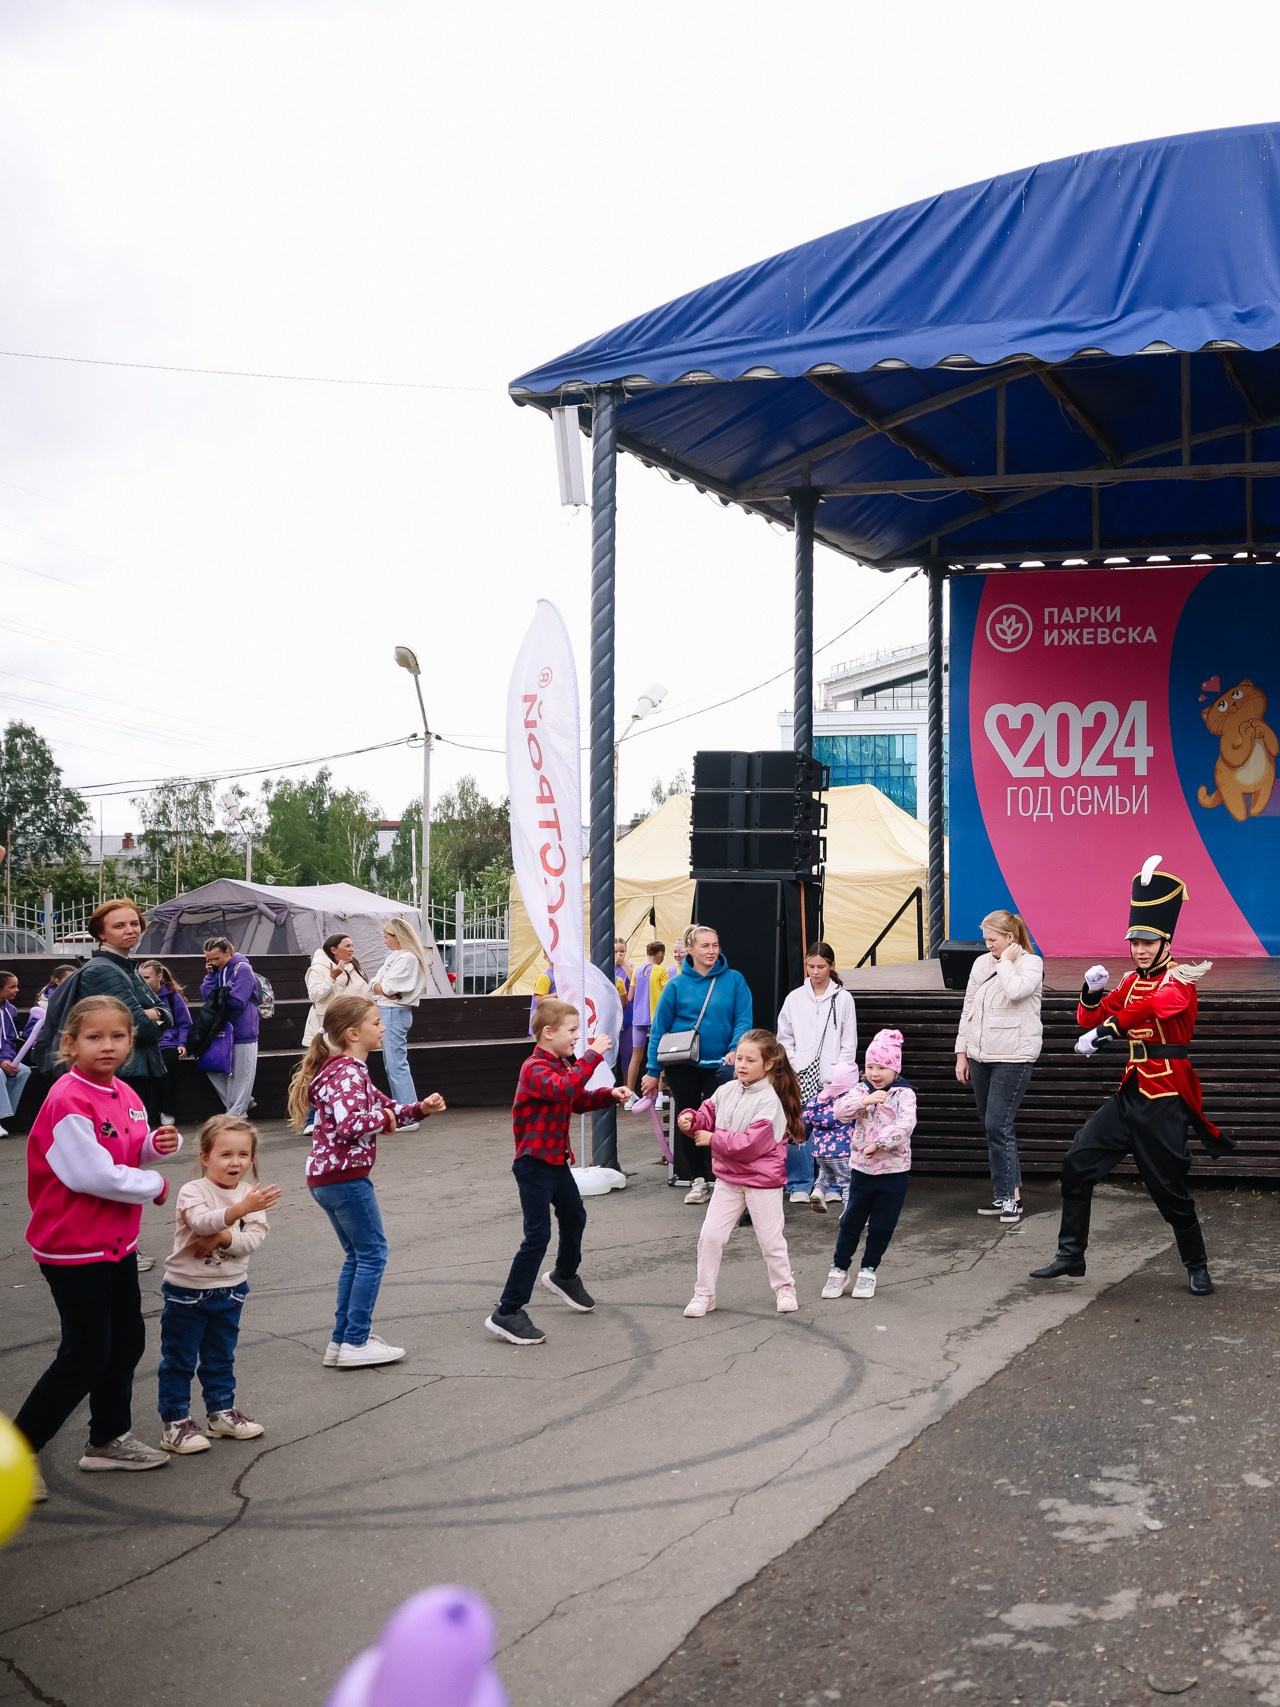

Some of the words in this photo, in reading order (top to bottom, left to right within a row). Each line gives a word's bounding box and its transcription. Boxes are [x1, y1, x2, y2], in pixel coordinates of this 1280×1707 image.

[1043, 605, 1121, 625] ПАРКИ
[1043, 626, 1158, 646] ИЖЕВСКА
[983, 700, 1154, 779] 2024
[1007, 786, 1054, 822] ГОД
